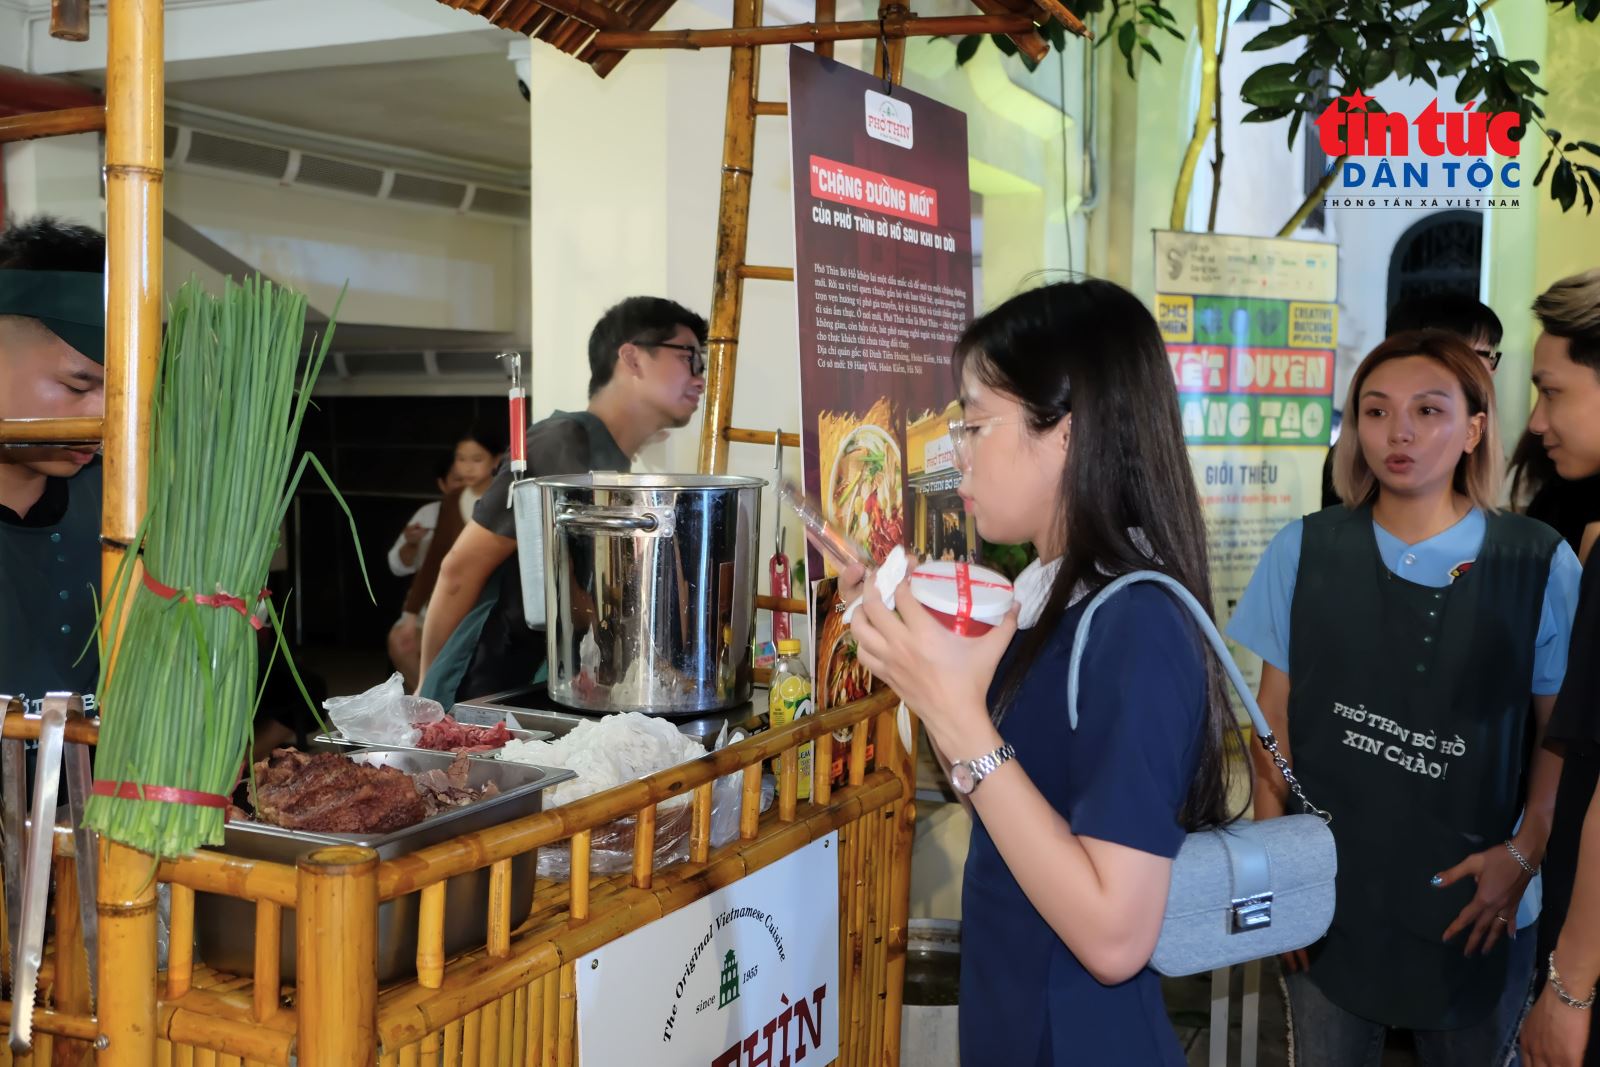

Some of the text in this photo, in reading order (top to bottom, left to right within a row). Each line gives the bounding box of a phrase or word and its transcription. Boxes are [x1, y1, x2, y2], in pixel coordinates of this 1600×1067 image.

[812, 165, 934, 218] "CHẶNG ĐƯỜNG MỚI"
[812, 201, 831, 226] CỦA
[833, 207, 852, 230] PHỞ
[854, 213, 875, 235] THÌN
[890, 221, 902, 241] HỒ
[903, 226, 918, 244] SAU
[920, 231, 933, 248] KHI
[934, 234, 942, 249] DI
[943, 232, 956, 253] DỜI
[817, 331, 826, 340] cho
[1237, 353, 1327, 388] DUYÊN
[1183, 398, 1250, 437] ÁNG
[1206, 460, 1277, 489] GIỚI THIỆU
[1333, 702, 1367, 723] PHỞ
[1441, 734, 1466, 757] HỒ
[1342, 730, 1448, 780] XIN CHÀO!
[663, 907, 786, 1043] The Original Vietnamese Cuisine
[742, 964, 759, 985] 1955
[696, 994, 716, 1015] since
